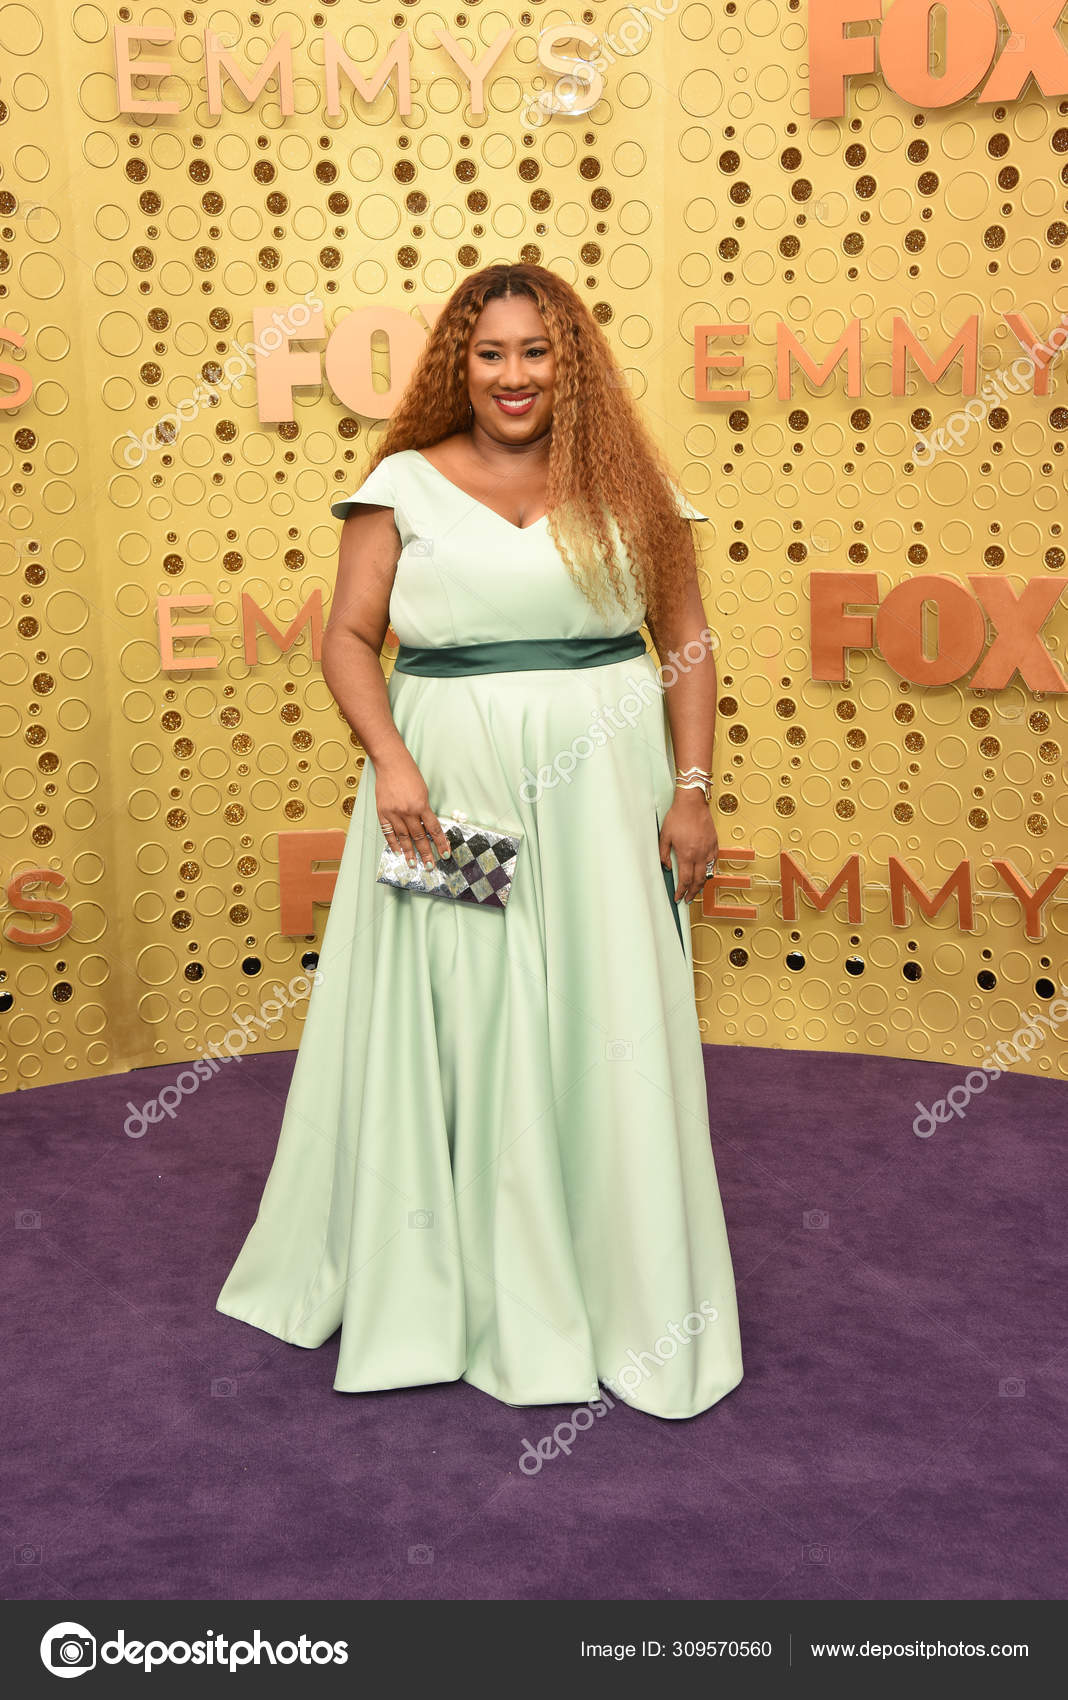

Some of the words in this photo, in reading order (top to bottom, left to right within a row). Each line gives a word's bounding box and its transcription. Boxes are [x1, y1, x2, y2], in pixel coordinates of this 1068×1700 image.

[114, 23, 603, 116] EMMYS
[809, 0, 1068, 119] FOX
[253, 304, 450, 423] FO
[694, 314, 1068, 402] EMMY
[157, 588, 324, 671] EM
[810, 572, 1068, 693] FOX
[3, 867, 74, 947] S
[702, 847, 1068, 939] EMMY
